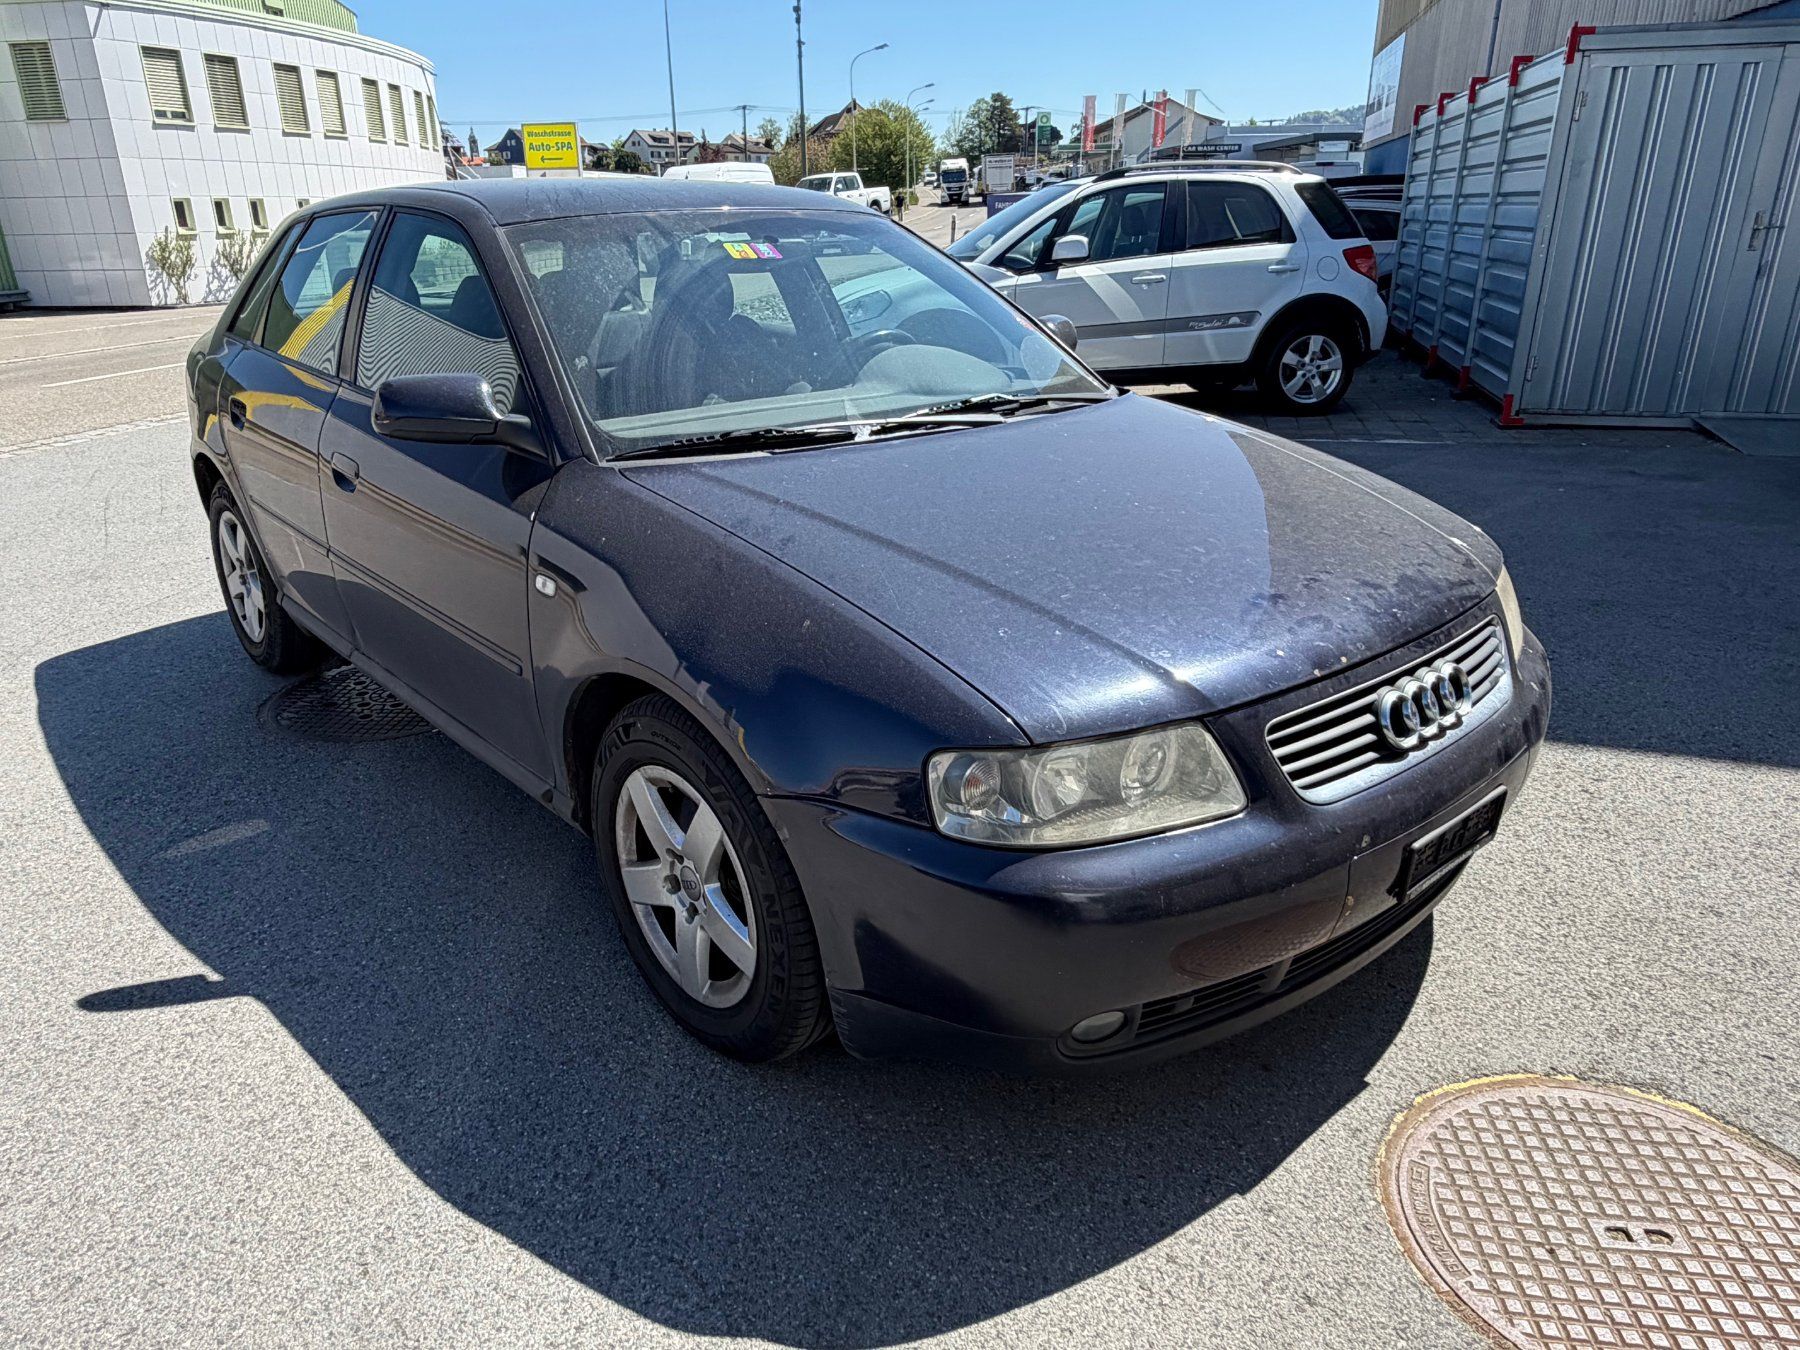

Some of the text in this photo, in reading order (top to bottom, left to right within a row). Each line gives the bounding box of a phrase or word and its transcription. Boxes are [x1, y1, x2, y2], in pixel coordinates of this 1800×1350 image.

[527, 130, 572, 138] Waschstrasse
[528, 141, 573, 152] Auto-SPA
[650, 730, 682, 751] OUTSIDE
[761, 893, 786, 1013] NEXEN
